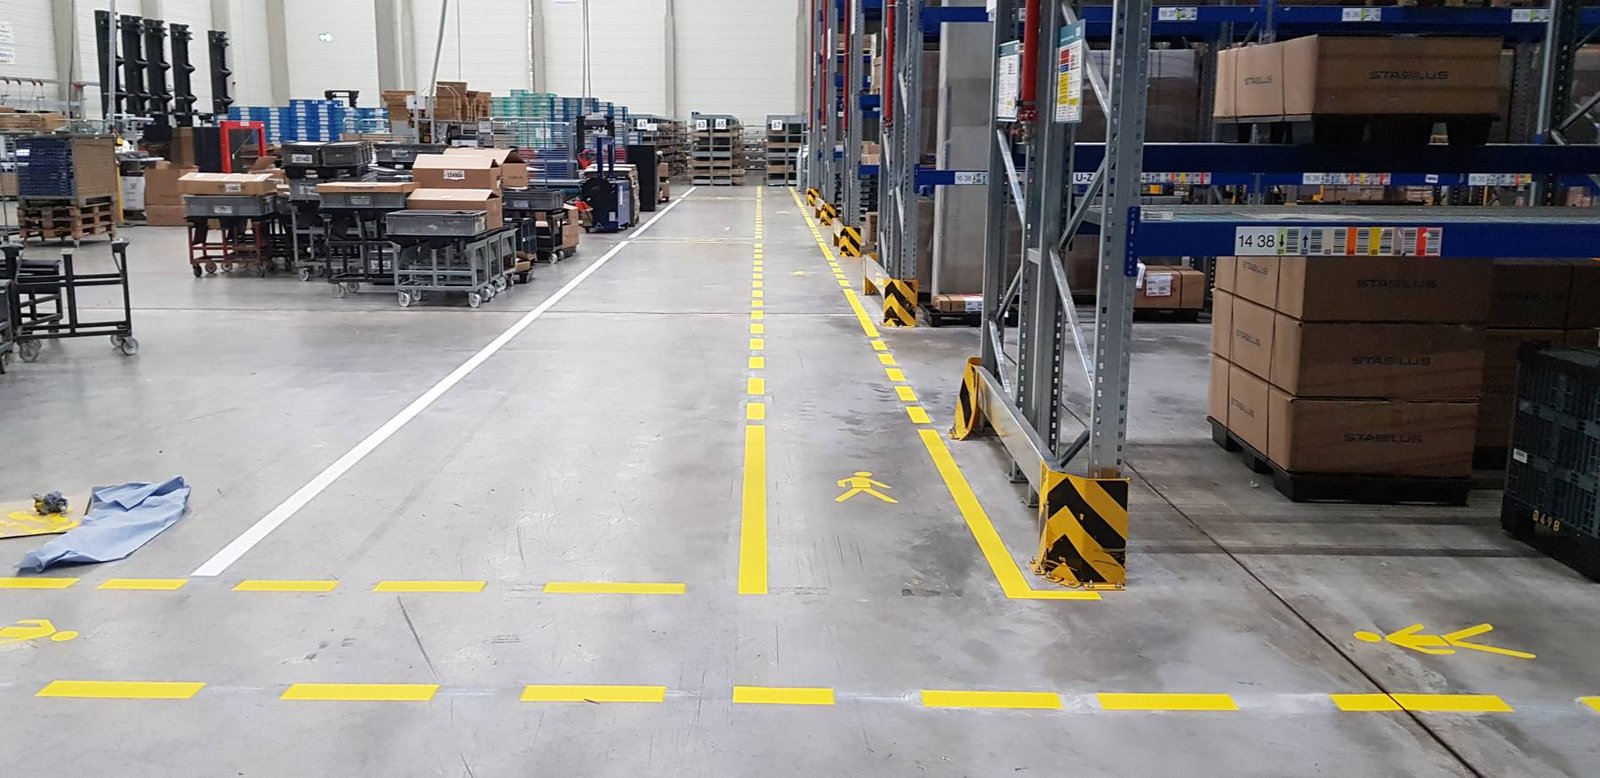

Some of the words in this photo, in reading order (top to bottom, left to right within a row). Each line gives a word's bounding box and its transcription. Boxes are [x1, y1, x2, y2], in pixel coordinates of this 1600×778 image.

[1368, 70, 1449, 80] STABILUS
[697, 121, 706, 129] 63
[716, 120, 725, 128] 65
[772, 121, 781, 129] 67
[1239, 234, 1254, 248] 14
[1257, 234, 1275, 248] 38
[1352, 356, 1431, 366] STABILUS
[1344, 432, 1423, 443] STABILUS
